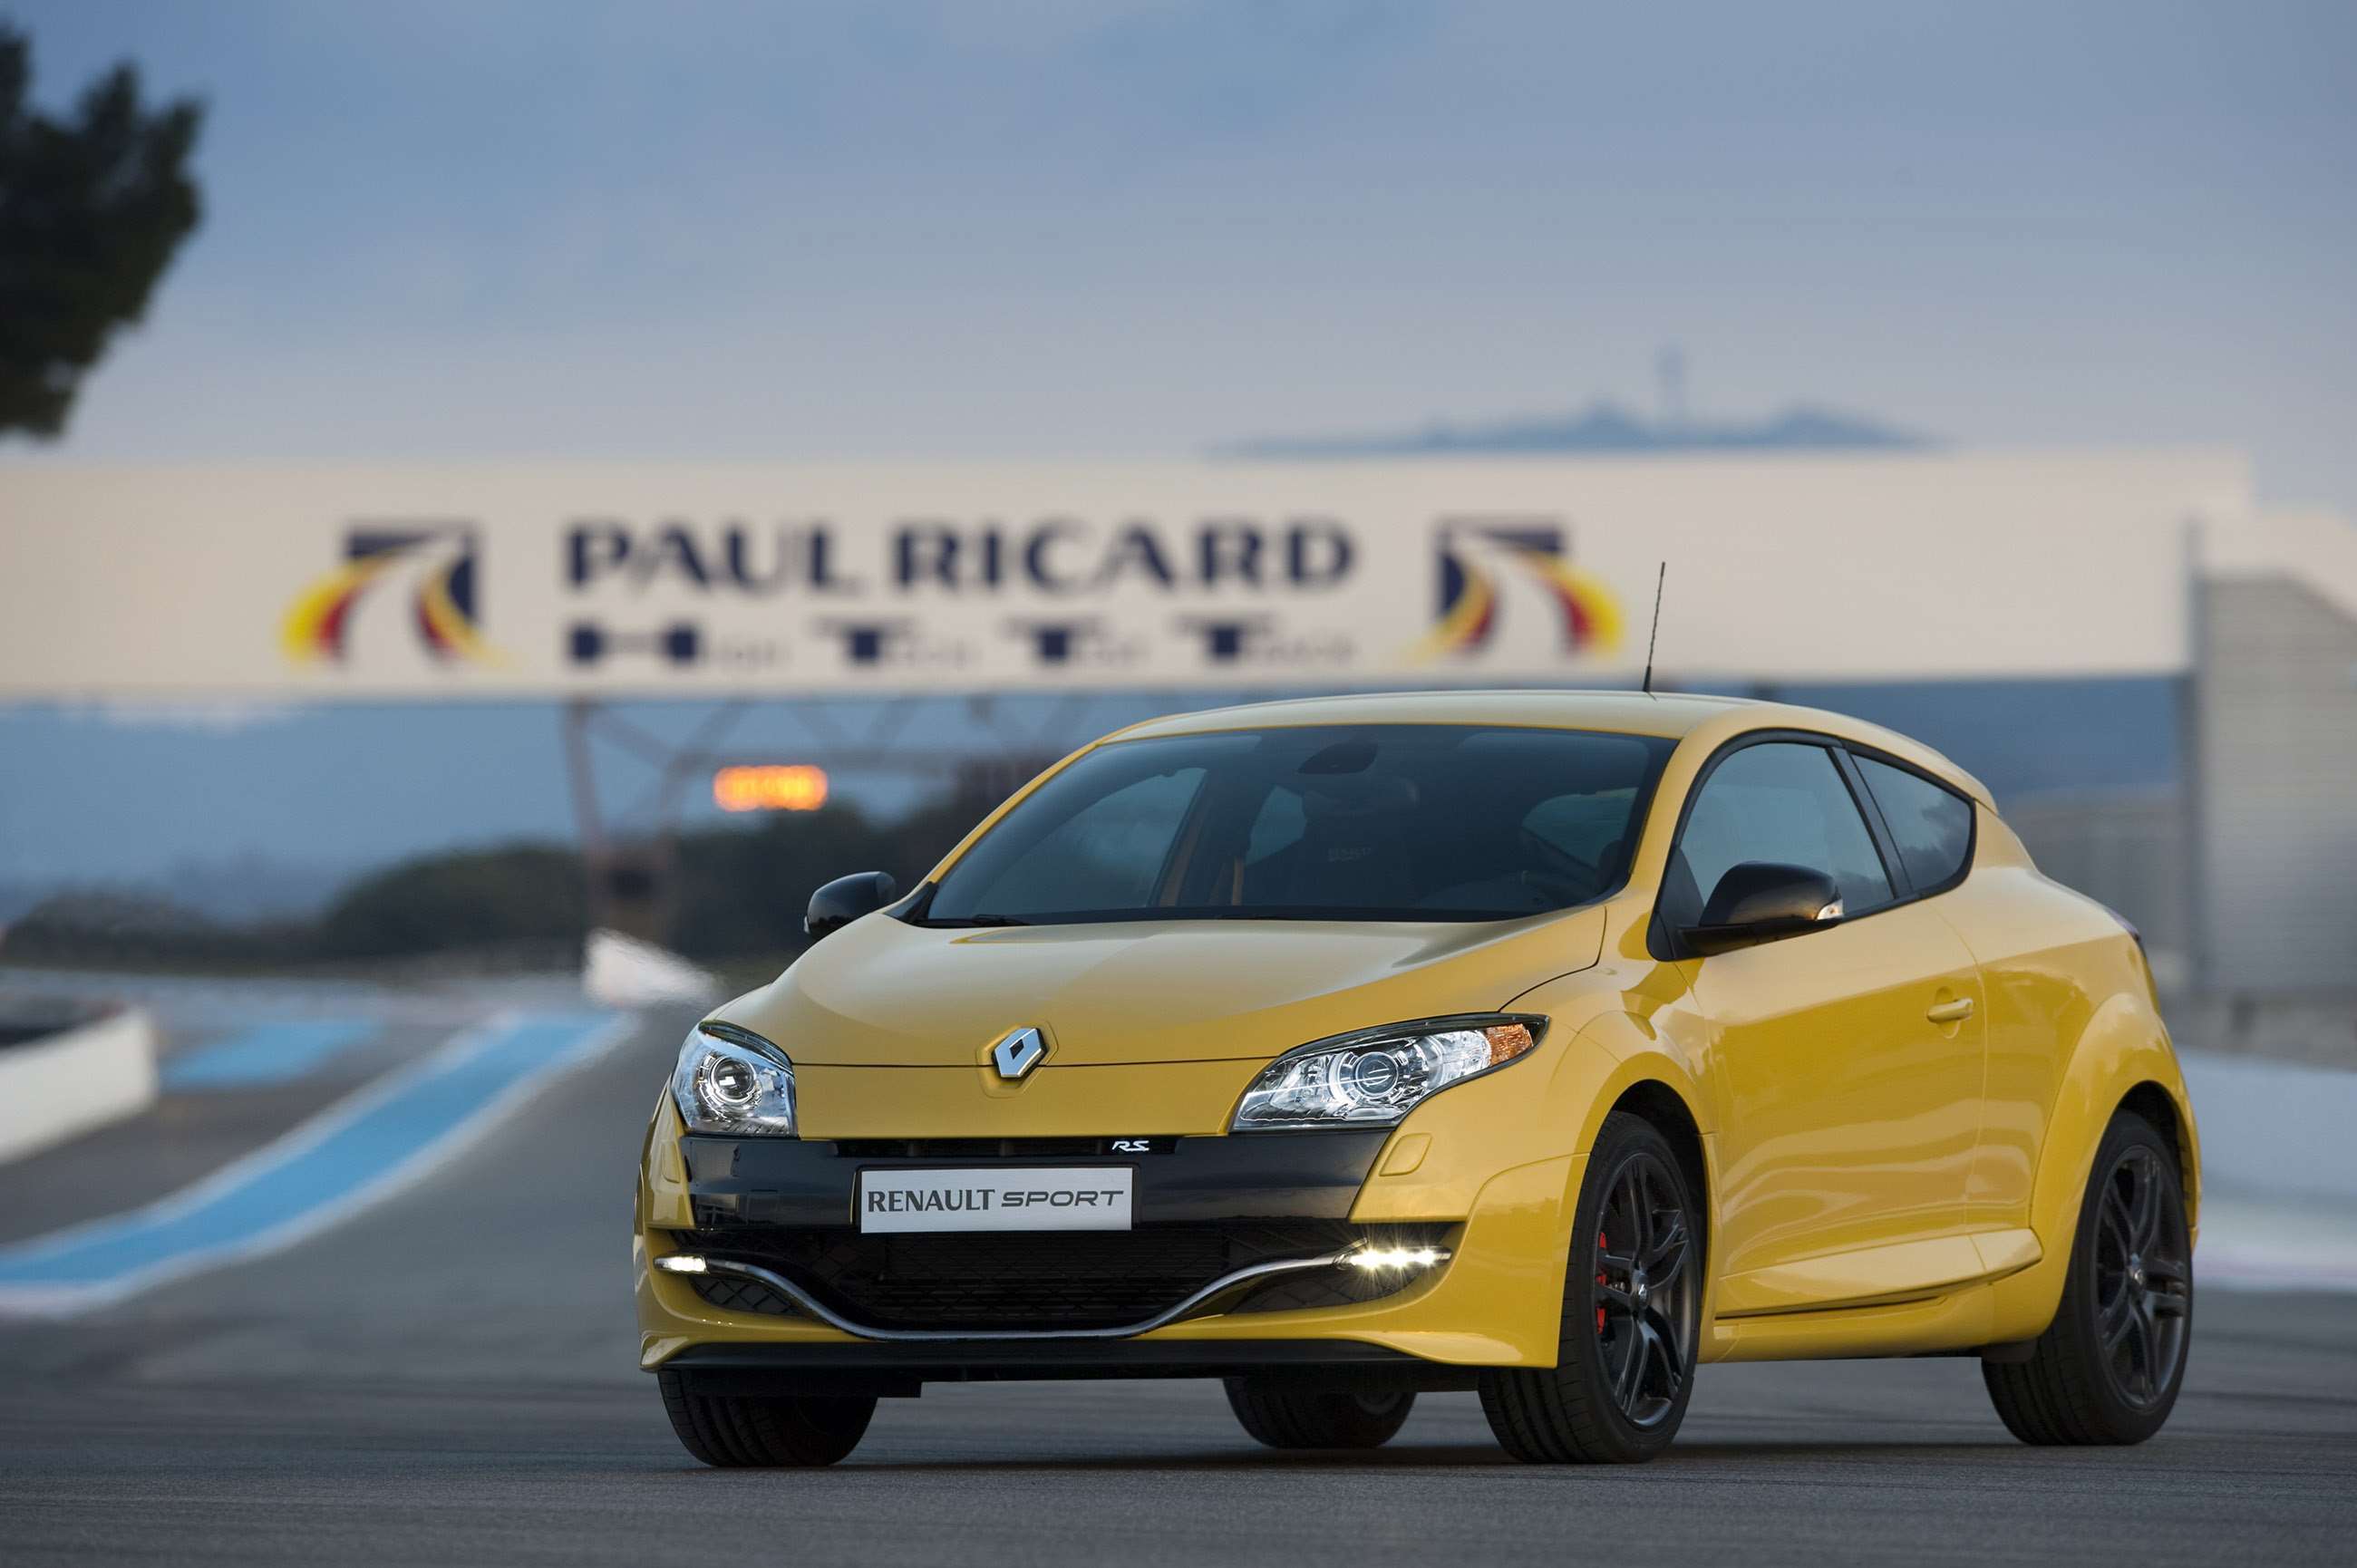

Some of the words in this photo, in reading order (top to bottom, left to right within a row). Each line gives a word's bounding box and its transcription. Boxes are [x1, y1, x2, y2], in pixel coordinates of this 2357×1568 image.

[564, 518, 867, 595] PAUL
[894, 516, 1359, 595] RICARD
[1111, 1140, 1149, 1152] RS
[868, 1188, 995, 1213] RENAULT
[1001, 1190, 1124, 1207] SPORT
